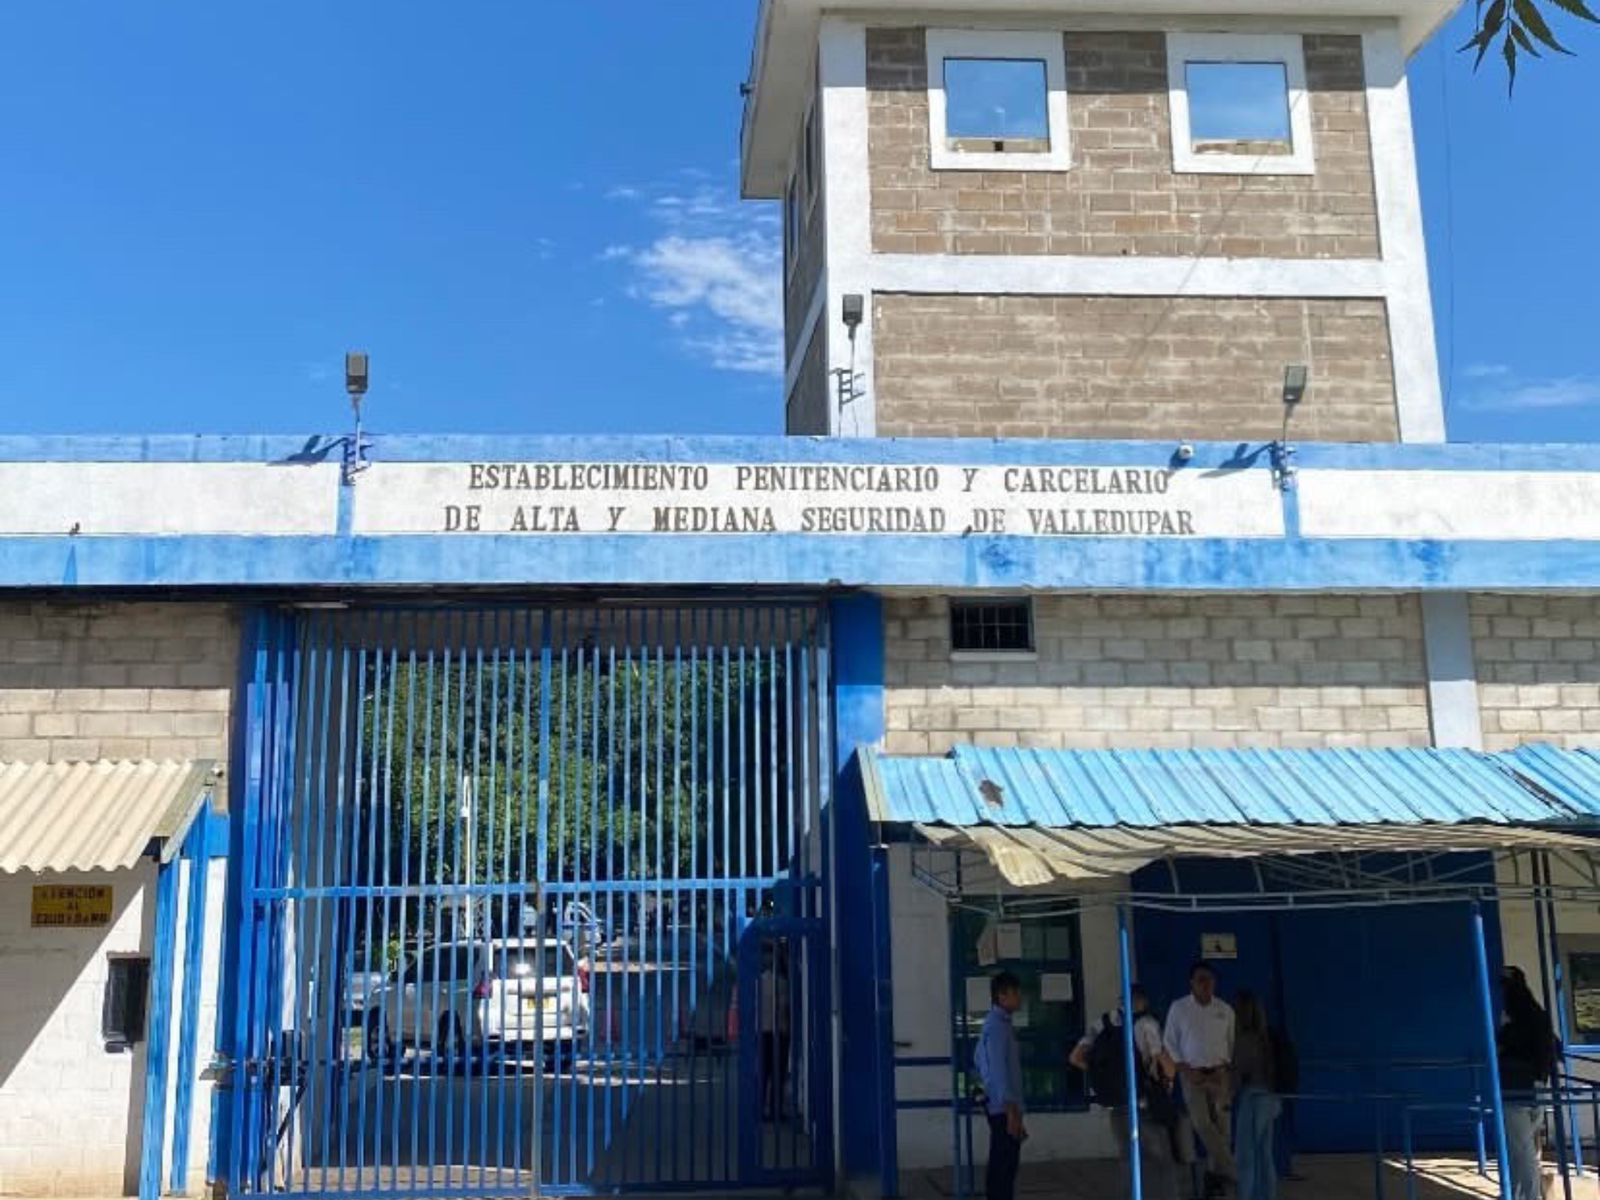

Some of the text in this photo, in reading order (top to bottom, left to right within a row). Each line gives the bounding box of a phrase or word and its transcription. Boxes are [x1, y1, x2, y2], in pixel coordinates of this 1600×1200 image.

[469, 464, 1169, 494] ESTABLECIMIENTO PENITENCIARIO Y CARCELARIO
[445, 505, 1195, 535] DE ALTA Y MEDIANA SEGURIDAD DE VALLEDUPAR
